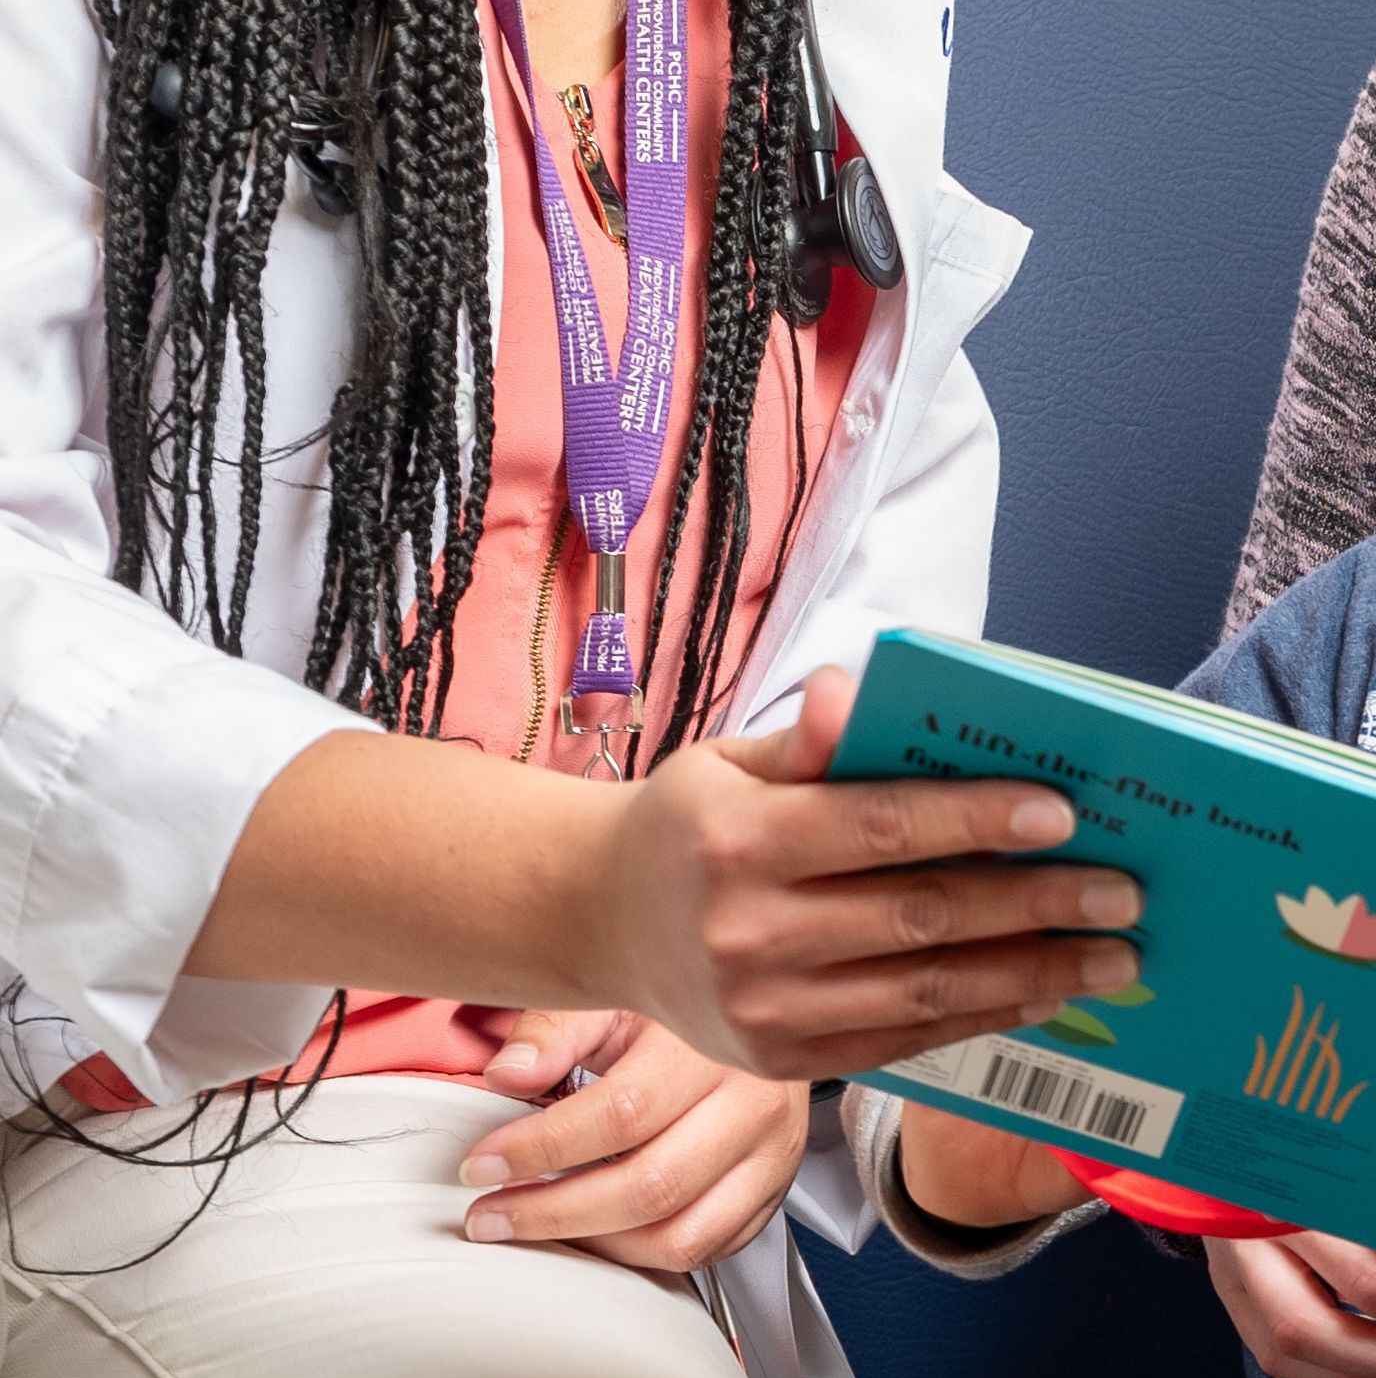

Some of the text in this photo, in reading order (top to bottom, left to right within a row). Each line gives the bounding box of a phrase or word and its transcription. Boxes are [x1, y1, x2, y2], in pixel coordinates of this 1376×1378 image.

[668, 50, 682, 105] PCHC
[635, 76, 651, 164] CENTERS
[652, 80, 664, 163] COMMUNITY
[558, 267, 573, 325] PCHC
[636, 255, 653, 334] HEALTH
[573, 298, 591, 384] PROVIDENCE
[582, 299, 605, 382] HEALTH
[634, 259, 663, 433] PROVIDENCE COMMUNITY
[658, 319, 675, 375] PCHC
[915, 711, 1303, 853] A lift-the-flap book
